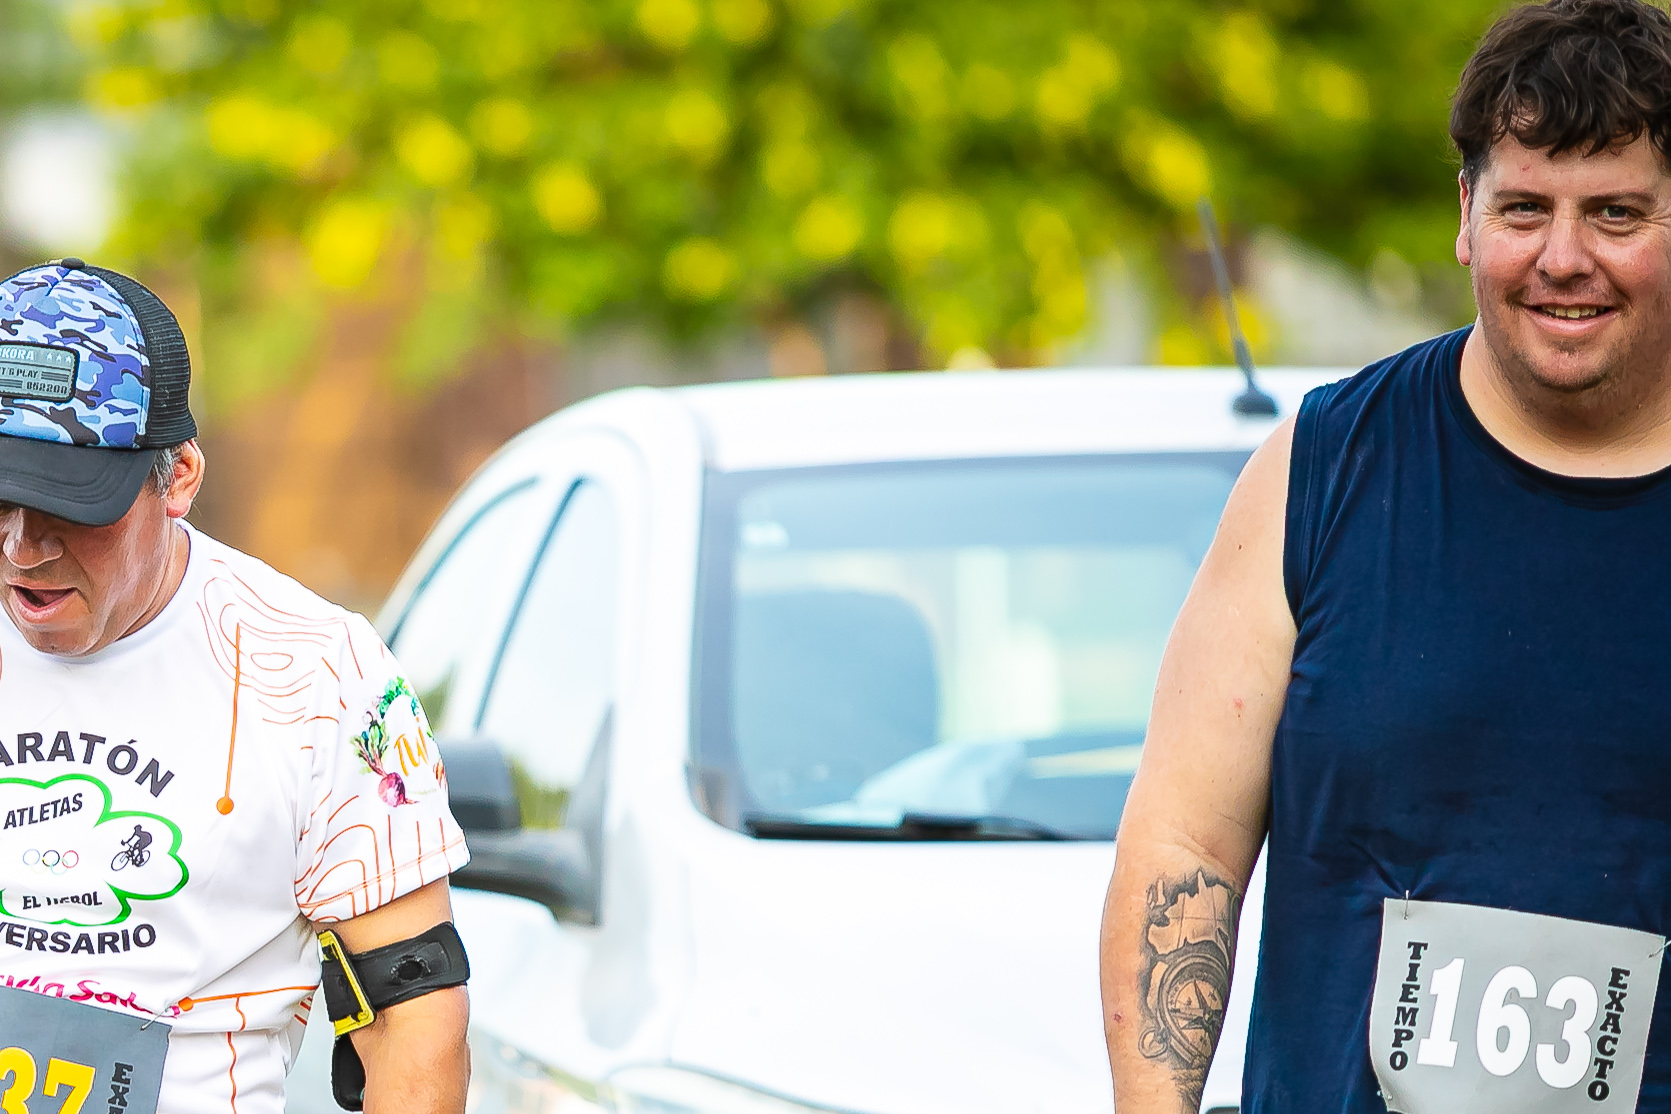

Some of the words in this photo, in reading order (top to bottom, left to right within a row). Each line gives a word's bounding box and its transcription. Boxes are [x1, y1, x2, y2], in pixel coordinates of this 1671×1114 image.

[17, 369, 38, 378] PLAY
[3, 793, 83, 829] ATLETAS
[22, 895, 41, 910] EL
[1389, 942, 1428, 1071] TIEMPO
[1417, 958, 1599, 1089] 163
[1588, 967, 1631, 1101] EXACTO
